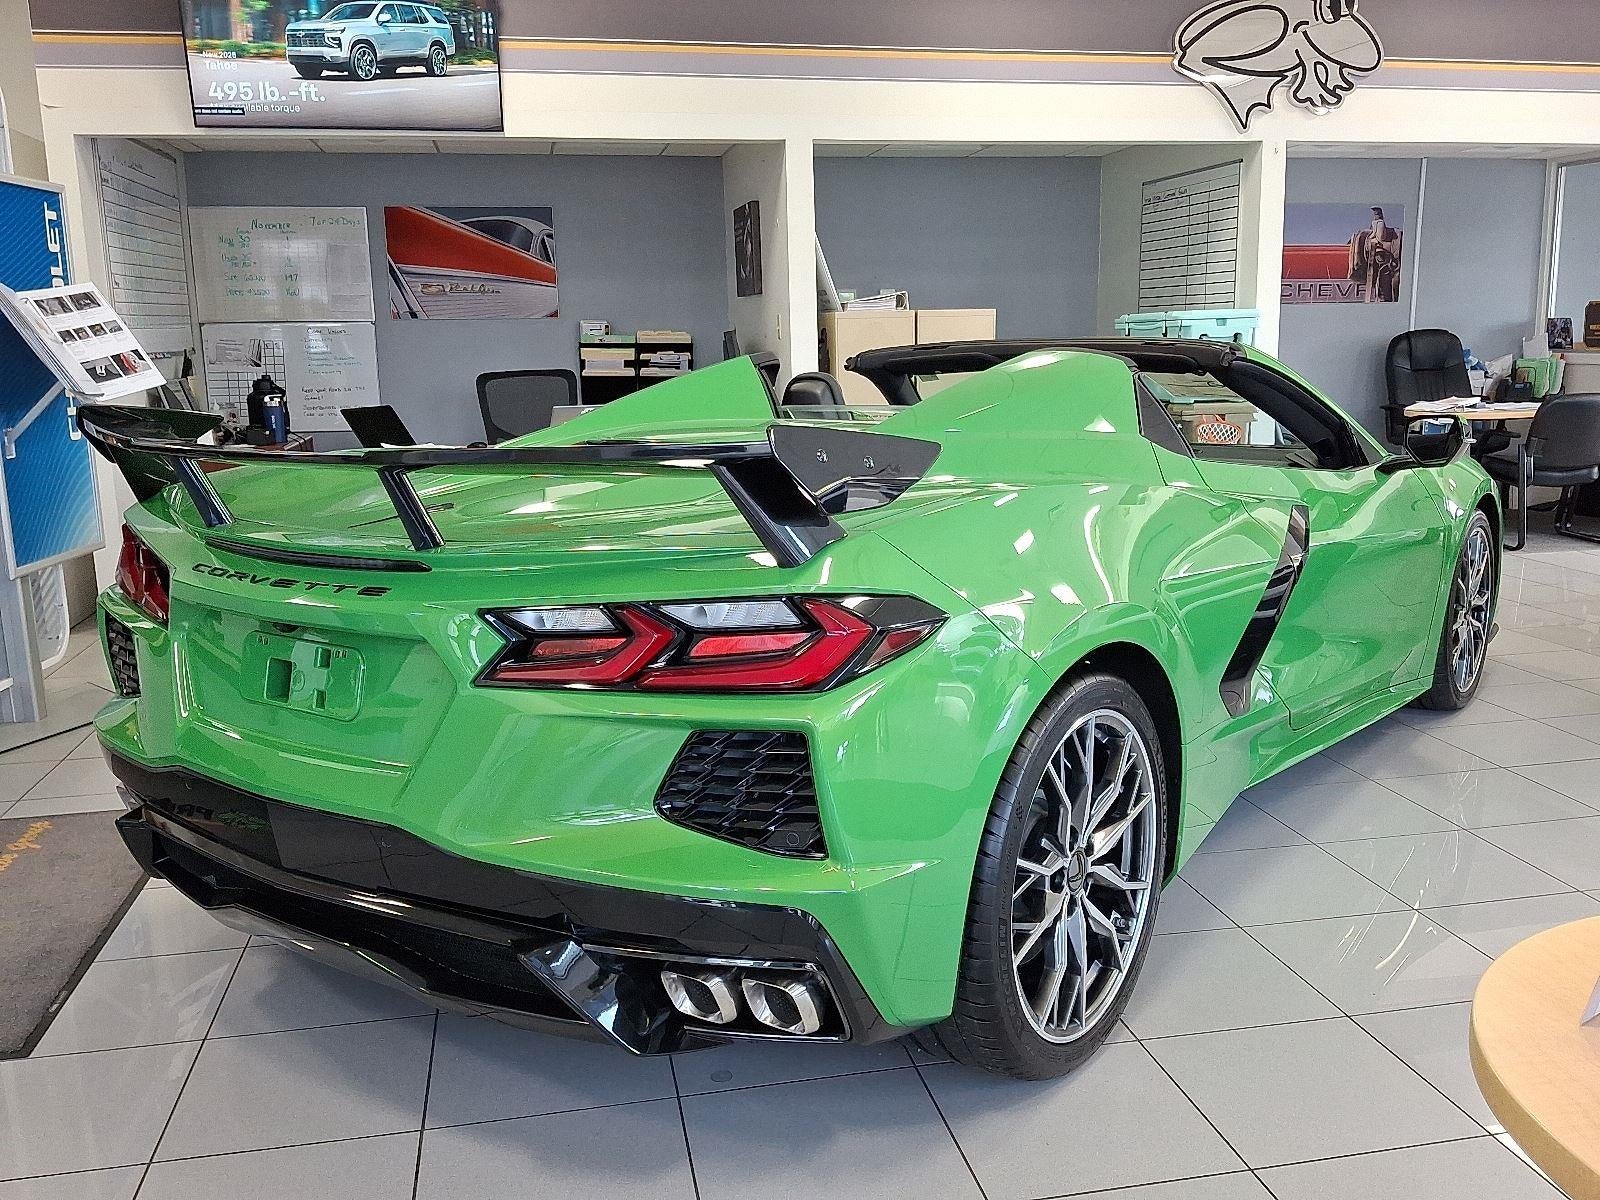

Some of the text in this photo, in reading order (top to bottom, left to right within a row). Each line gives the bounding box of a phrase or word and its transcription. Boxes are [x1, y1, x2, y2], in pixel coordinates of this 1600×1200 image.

[205, 60, 238, 71] Tahoe
[208, 81, 326, 102] 495 lb.-ft.
[270, 103, 301, 113] torque
[192, 563, 393, 597] CORVETTE
